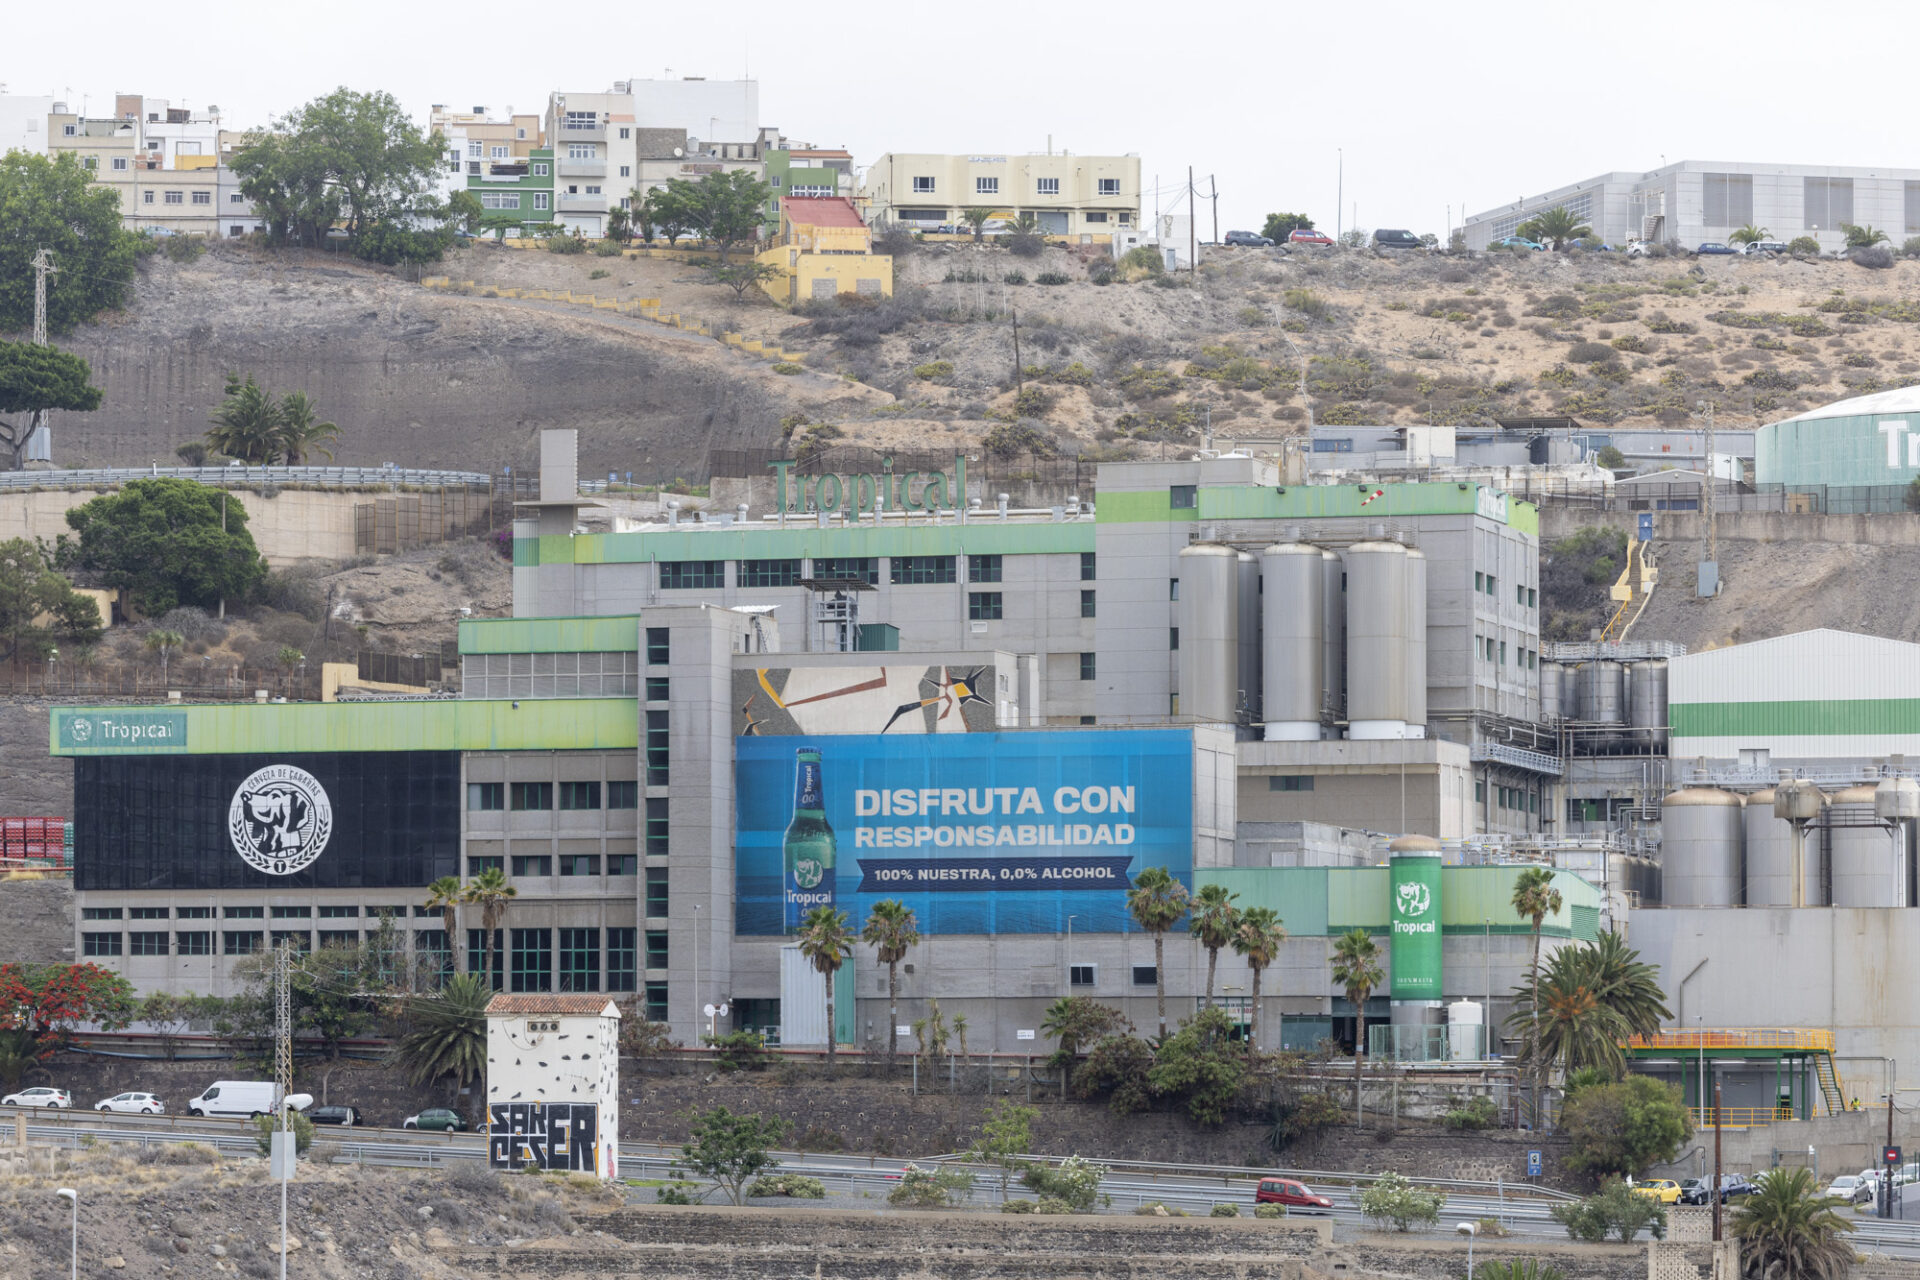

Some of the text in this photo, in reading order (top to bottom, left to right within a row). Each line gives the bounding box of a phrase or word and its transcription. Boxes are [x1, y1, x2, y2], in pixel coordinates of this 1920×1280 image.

[767, 454, 968, 523] Tropical
[101, 720, 173, 742] Tropical
[247, 769, 276, 789] CERVEZA
[278, 768, 287, 778] DE
[804, 765, 813, 793] Tropical
[855, 785, 1135, 817] DISFRUTA CON
[855, 823, 1135, 848] RESPONSABILIDAD
[874, 866, 1116, 882] 100% NUESTRA, 0,0% ALCOHOL
[786, 889, 832, 906] Tropical
[1393, 920, 1435, 935] Tropical
